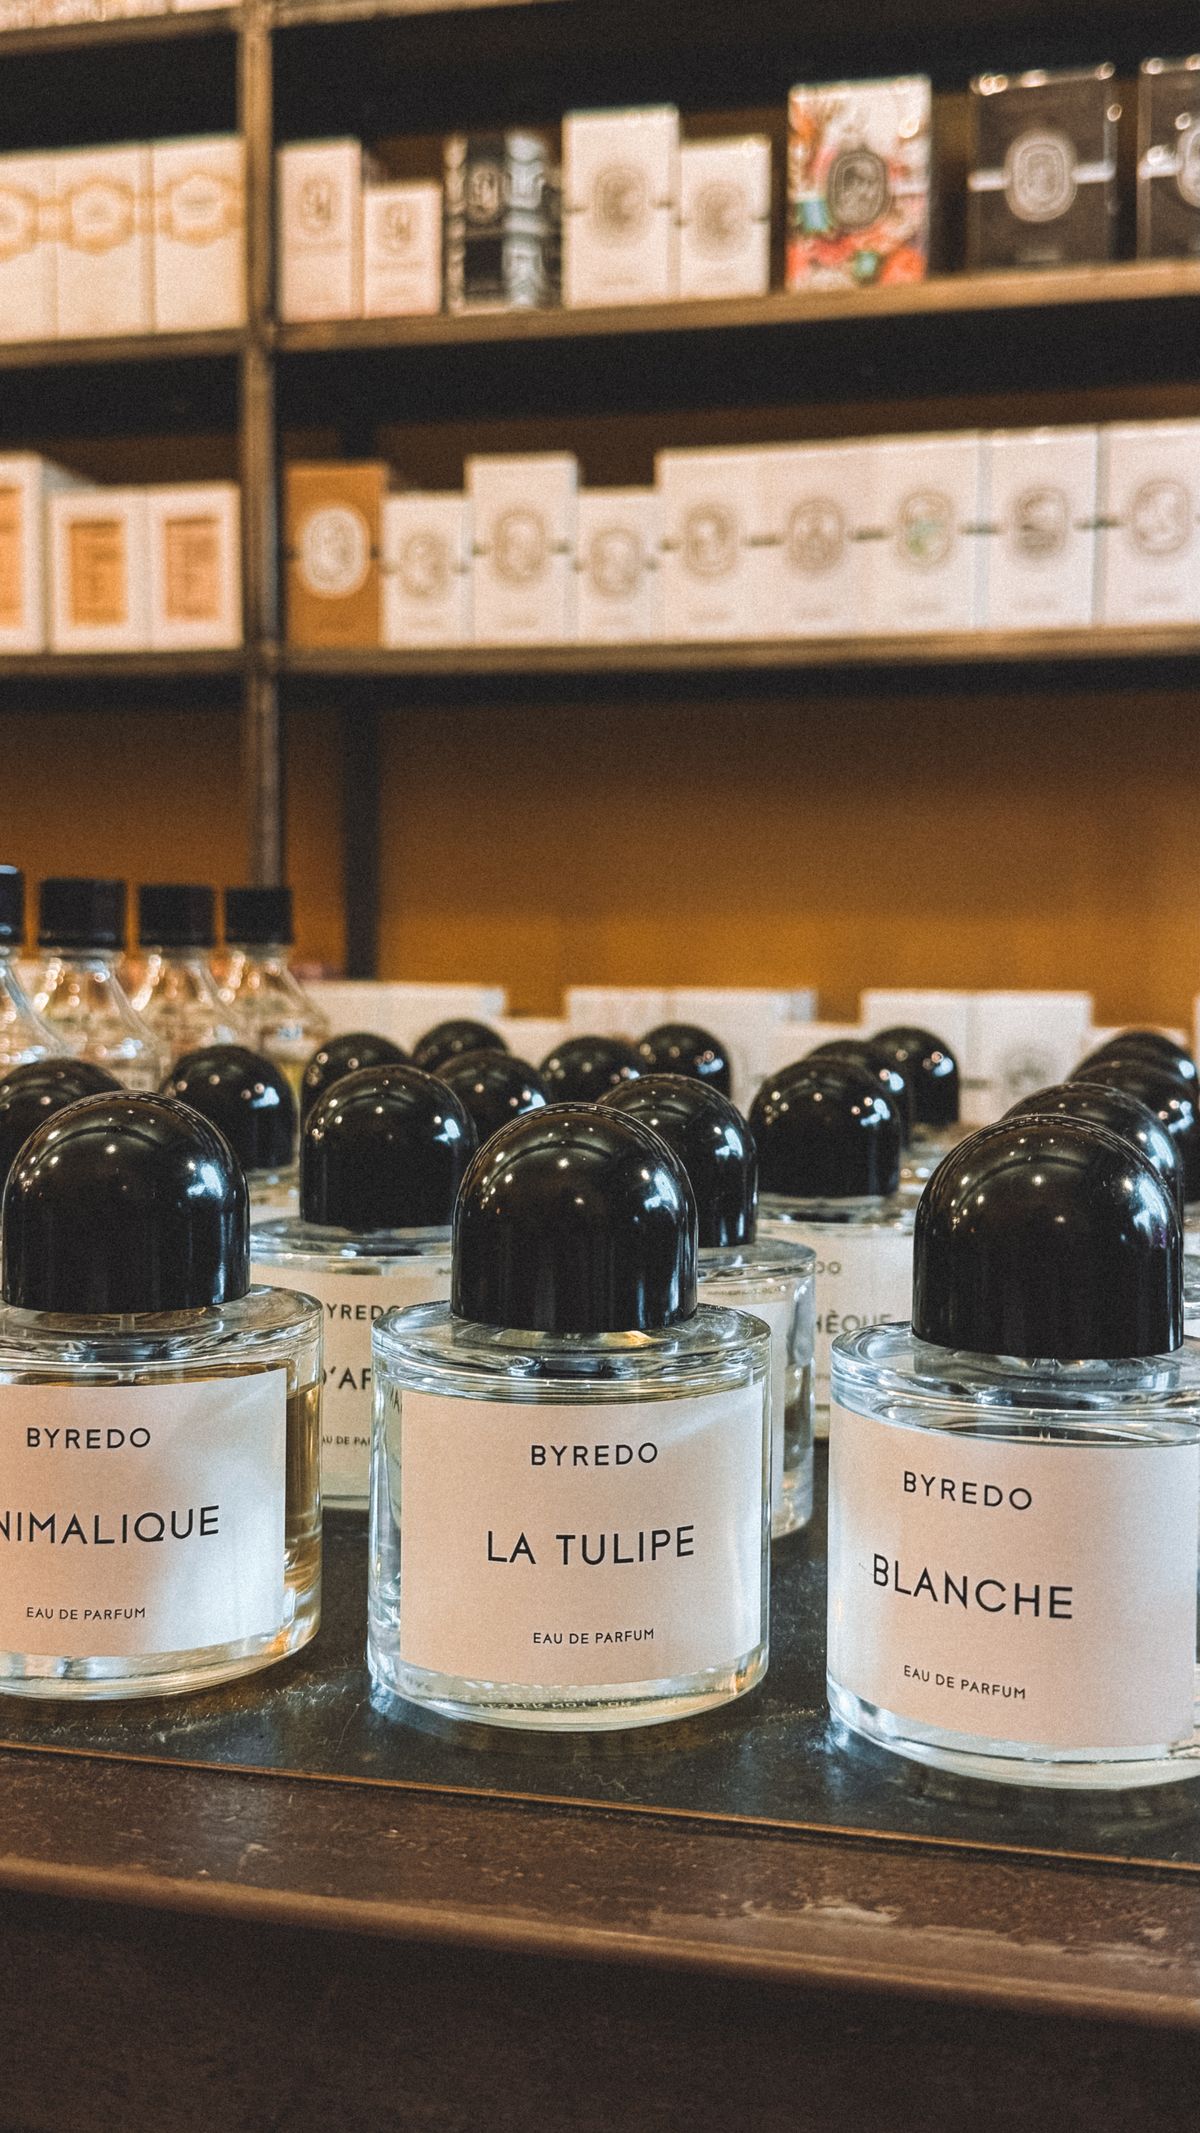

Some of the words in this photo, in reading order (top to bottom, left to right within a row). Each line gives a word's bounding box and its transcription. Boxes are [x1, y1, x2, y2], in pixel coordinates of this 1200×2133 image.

[27, 1427, 151, 1449] BYREDO
[531, 1442, 658, 1466] BYREDO
[903, 1470, 1033, 1511] BYREDO
[487, 1530, 537, 1565] LA
[555, 1524, 694, 1566] TULIPE
[873, 1553, 1073, 1619] BLANCHE
[26, 1606, 54, 1620] EAU
[59, 1609, 79, 1620] DE
[84, 1607, 146, 1620] PARFUM
[533, 1632, 563, 1644] EAU
[569, 1633, 589, 1645] DE
[595, 1628, 655, 1644] PARFUM
[903, 1664, 930, 1683] EAU
[935, 1673, 955, 1689] DE
[960, 1678, 1026, 1700] PARFUM
